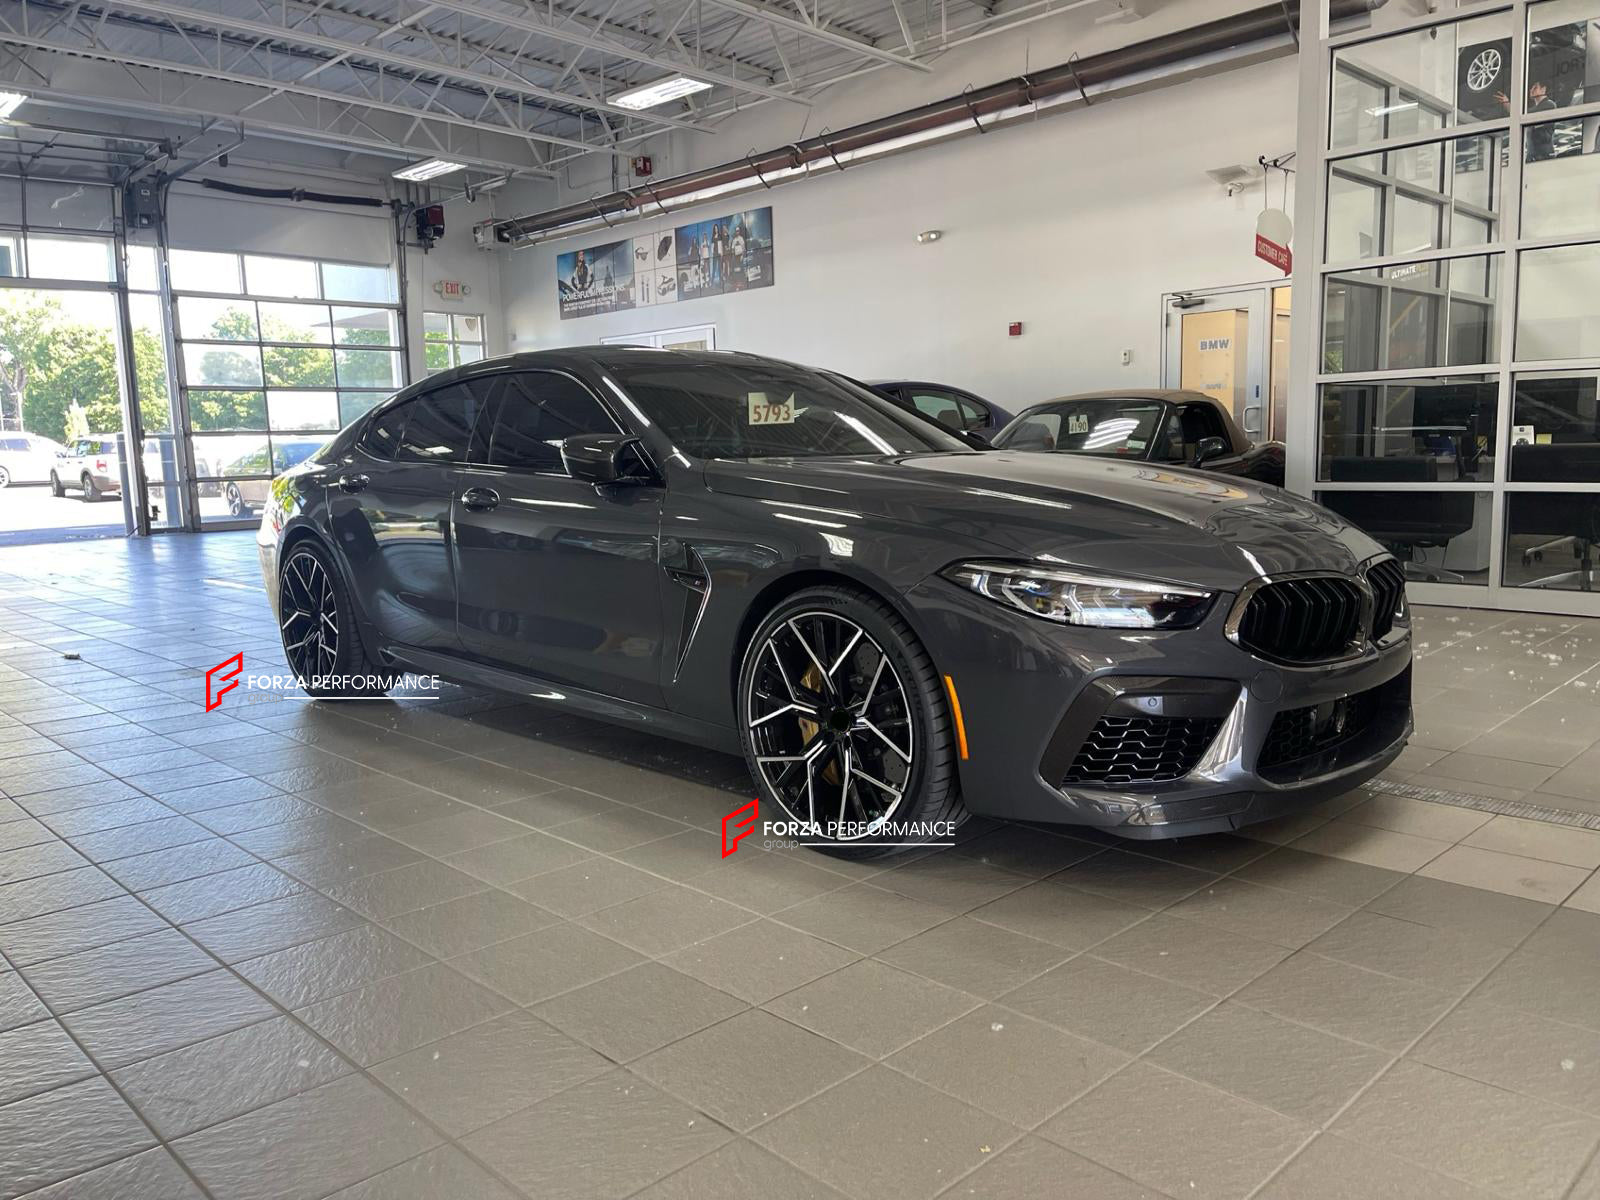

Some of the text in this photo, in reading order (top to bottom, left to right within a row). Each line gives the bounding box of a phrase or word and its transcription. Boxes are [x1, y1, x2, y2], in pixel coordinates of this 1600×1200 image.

[1258, 240, 1278, 261] CUSTOMER
[446, 282, 459, 294] EXIT
[1200, 339, 1230, 350] BMW
[753, 404, 791, 422] 5793
